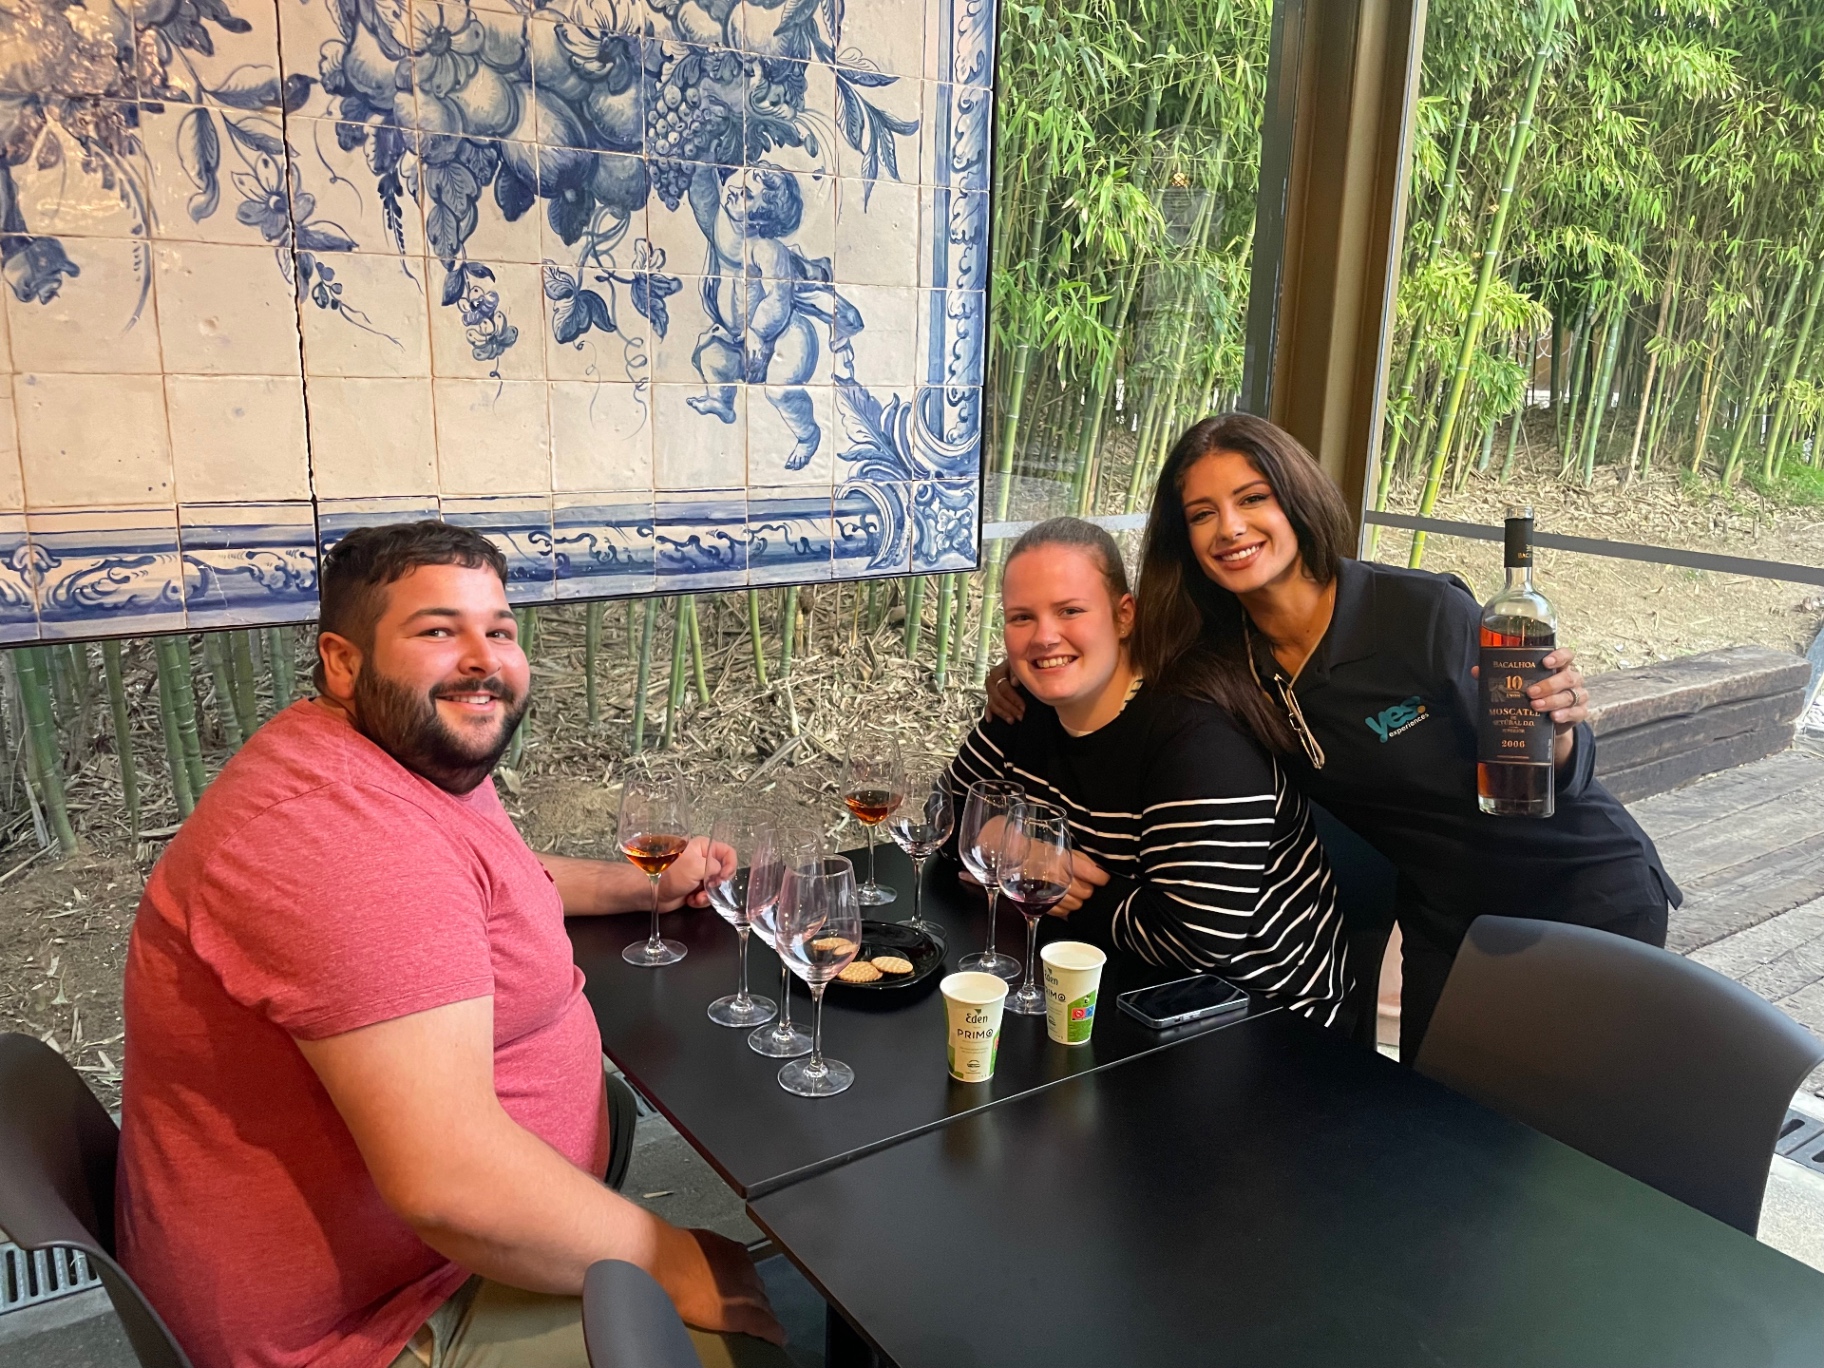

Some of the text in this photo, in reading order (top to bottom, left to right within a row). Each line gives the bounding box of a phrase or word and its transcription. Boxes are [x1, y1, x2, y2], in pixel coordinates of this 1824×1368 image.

[1505, 675, 1523, 691] 10
[1488, 707, 1541, 717] MOSCATEL
[1388, 712, 1430, 737] experiences
[1501, 740, 1525, 748] 2006
[965, 1012, 988, 1024] Eden
[957, 1028, 993, 1039] PRIMO
